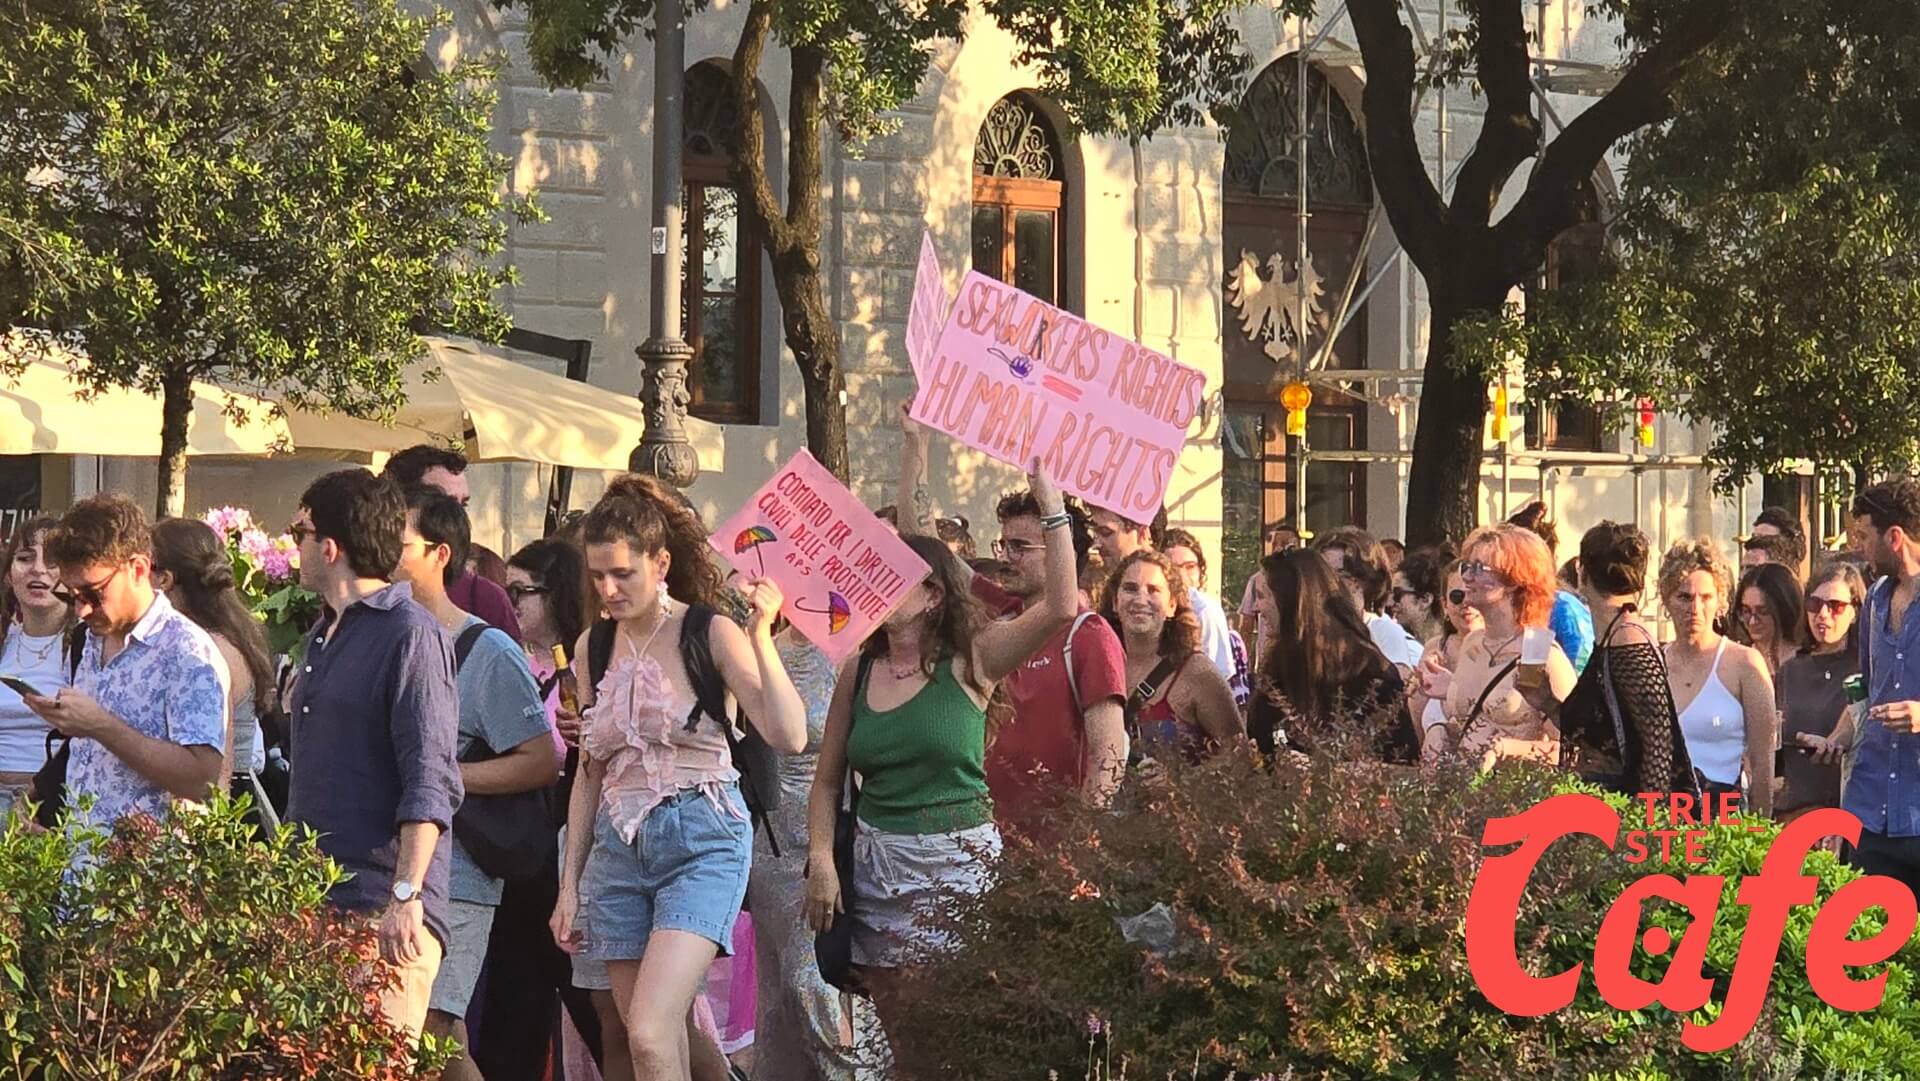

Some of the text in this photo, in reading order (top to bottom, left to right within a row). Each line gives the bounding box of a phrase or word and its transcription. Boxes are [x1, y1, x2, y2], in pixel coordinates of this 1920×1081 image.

[920, 356, 1175, 511] HUMAN RIGHTS
[776, 472, 833, 528] COMITATO
[825, 519, 853, 551] PER
[785, 553, 813, 576] APS
[788, 524, 826, 561] DELLE
[820, 555, 888, 621] PROSTITUTE
